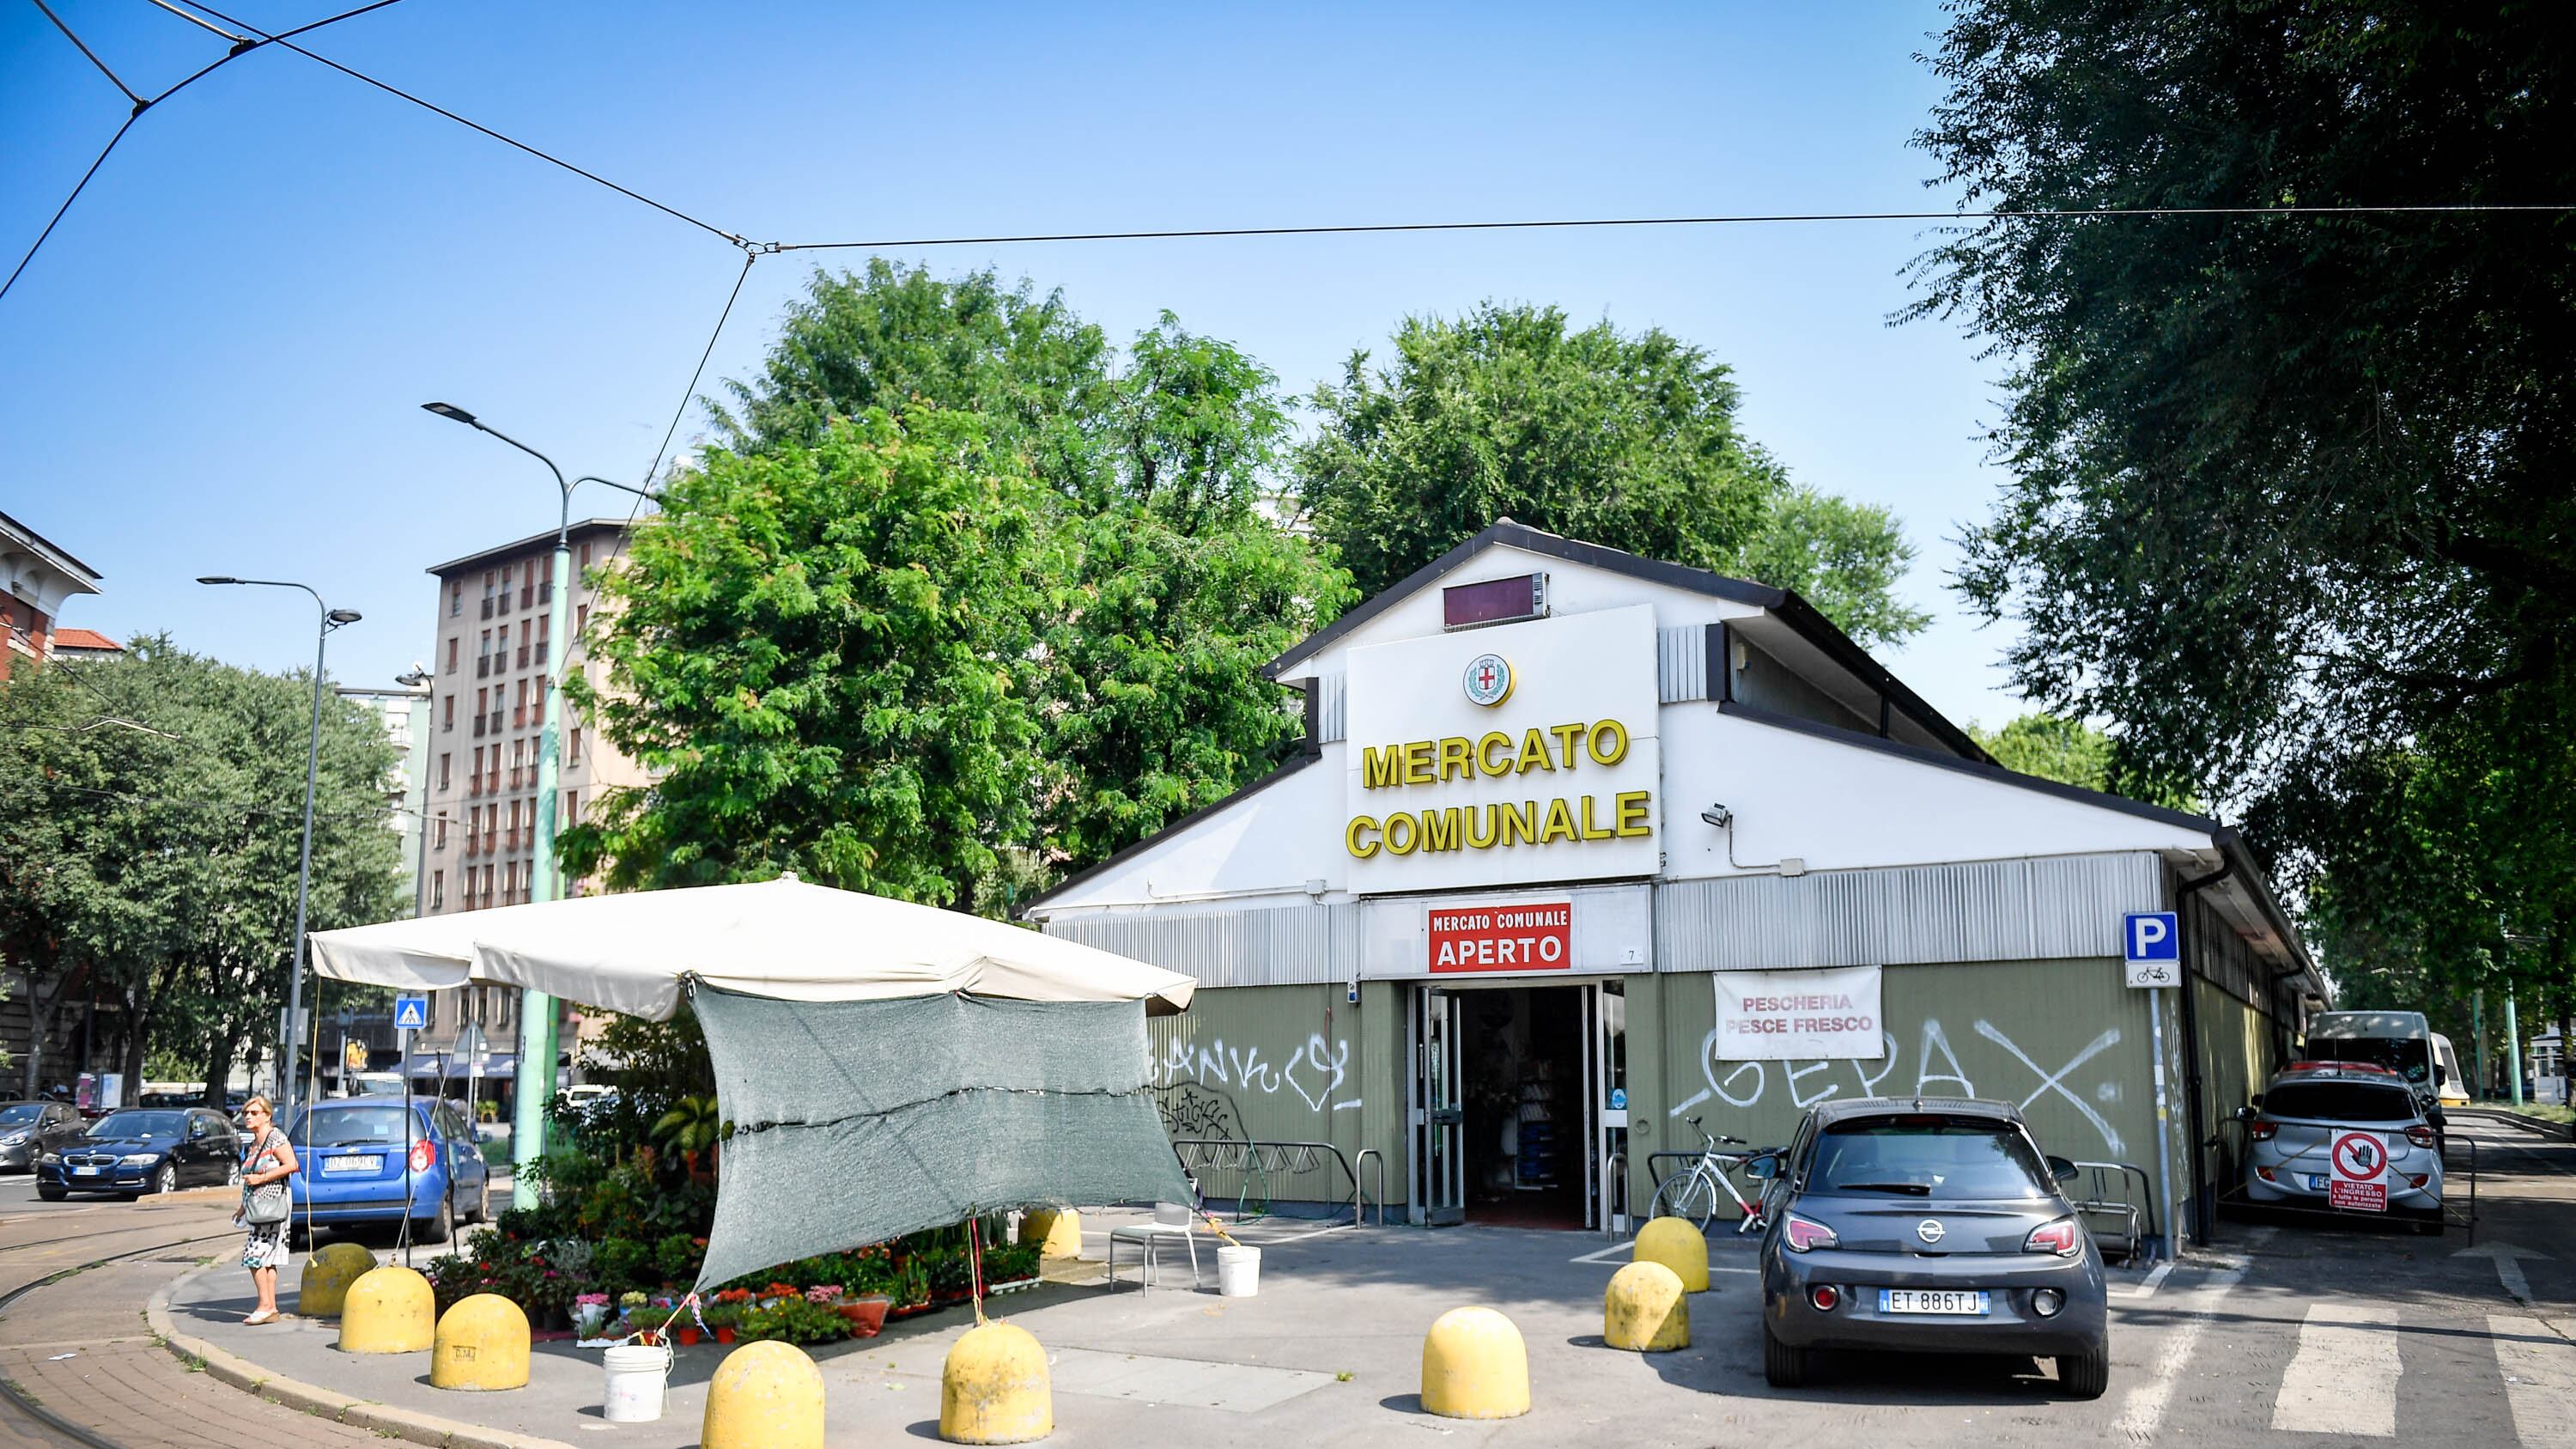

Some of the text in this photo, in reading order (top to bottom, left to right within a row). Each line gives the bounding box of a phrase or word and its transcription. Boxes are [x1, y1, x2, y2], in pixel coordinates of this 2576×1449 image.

[1363, 719, 1630, 788] MERCATO
[1346, 790, 1652, 859] COMUNALE
[1433, 910, 1568, 932] MERCATO COMUNALE
[2136, 917, 2166, 958] P
[1437, 935, 1562, 965] APERTO
[1628, 950, 1635, 962] 7
[1743, 995, 1853, 1012] PESCHERIA
[1726, 1016, 1873, 1034] PESCE FRESCO
[2334, 1187, 2383, 1197] L'INGRESSO
[2343, 1182, 2373, 1190] VIETATO
[1892, 1292, 1977, 1312] ET 886TJ
